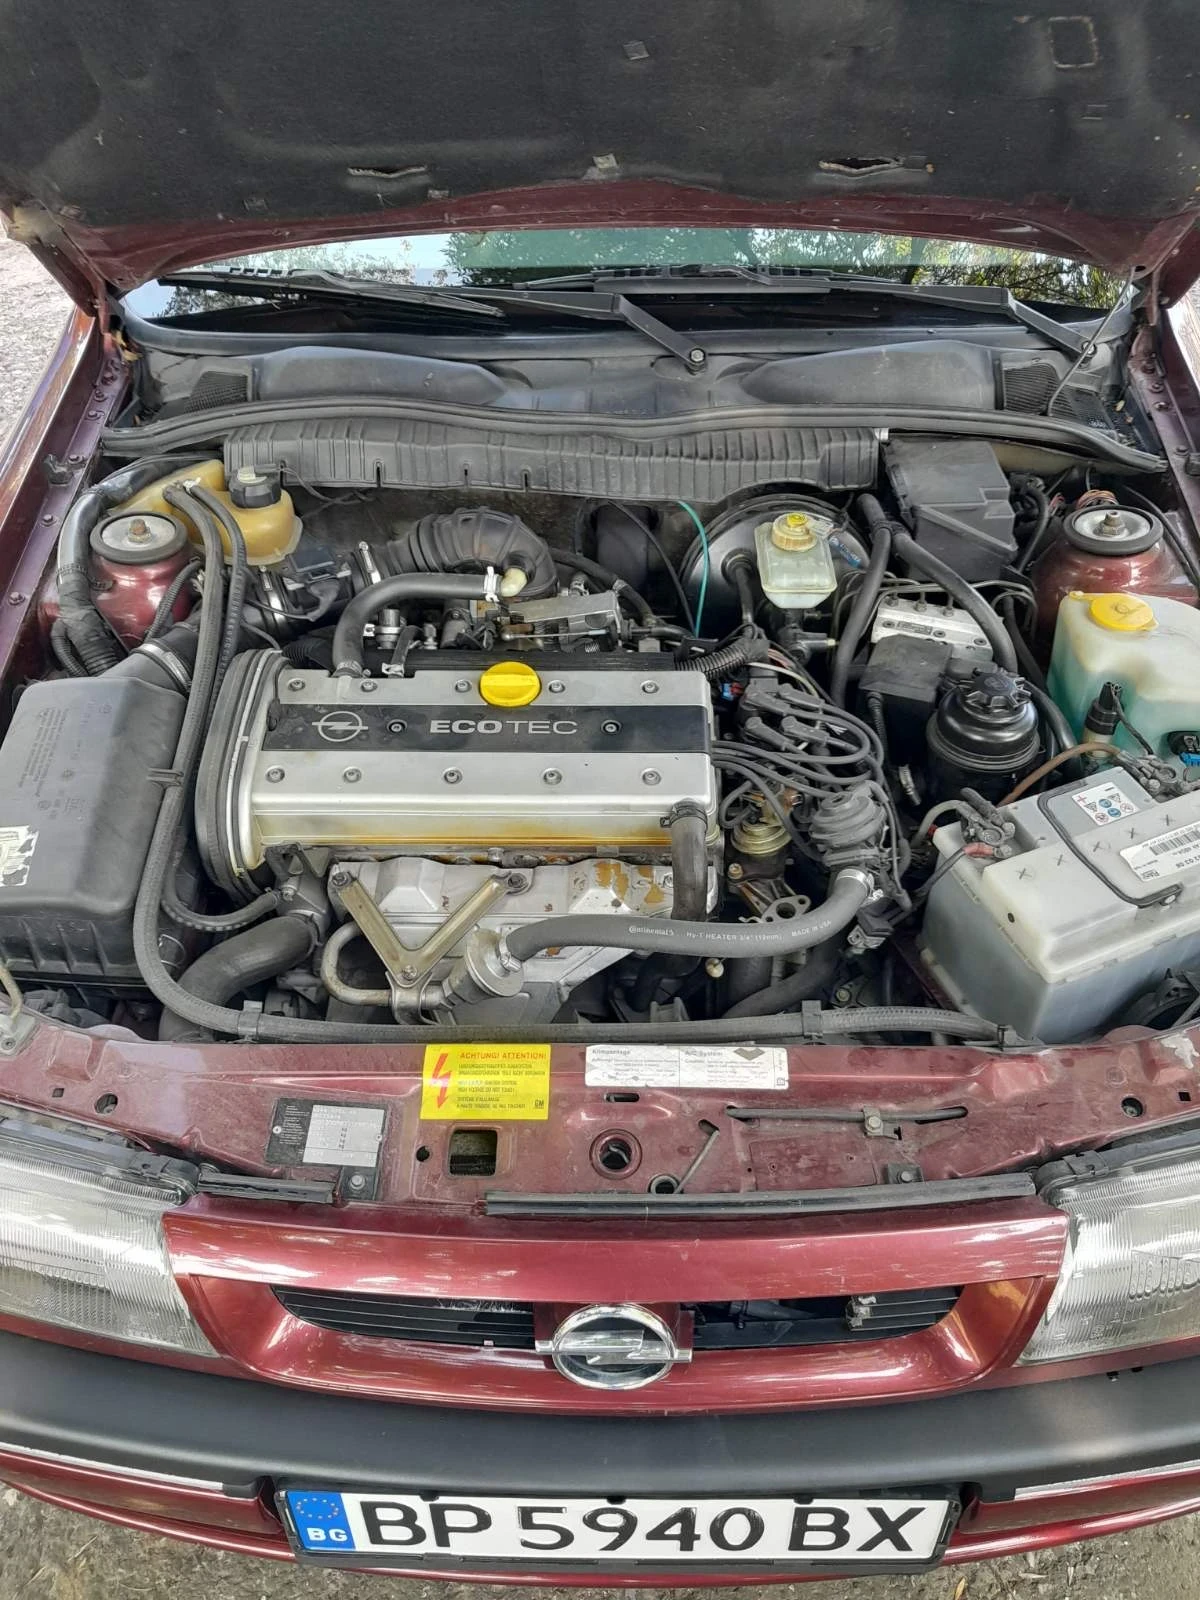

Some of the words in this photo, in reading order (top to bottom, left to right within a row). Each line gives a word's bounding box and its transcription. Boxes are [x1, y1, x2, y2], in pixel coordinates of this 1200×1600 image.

[430, 720, 577, 735] ECOTEC
[705, 933, 737, 941] HEATER
[791, 927, 810, 937] MADE
[460, 1051, 500, 1060] ACHTUNG!
[502, 1051, 547, 1060] ATTENTION!
[359, 1501, 492, 1548] BP
[517, 1506, 765, 1551] 5940
[787, 1506, 927, 1551] BX
[306, 1527, 348, 1542] BG
